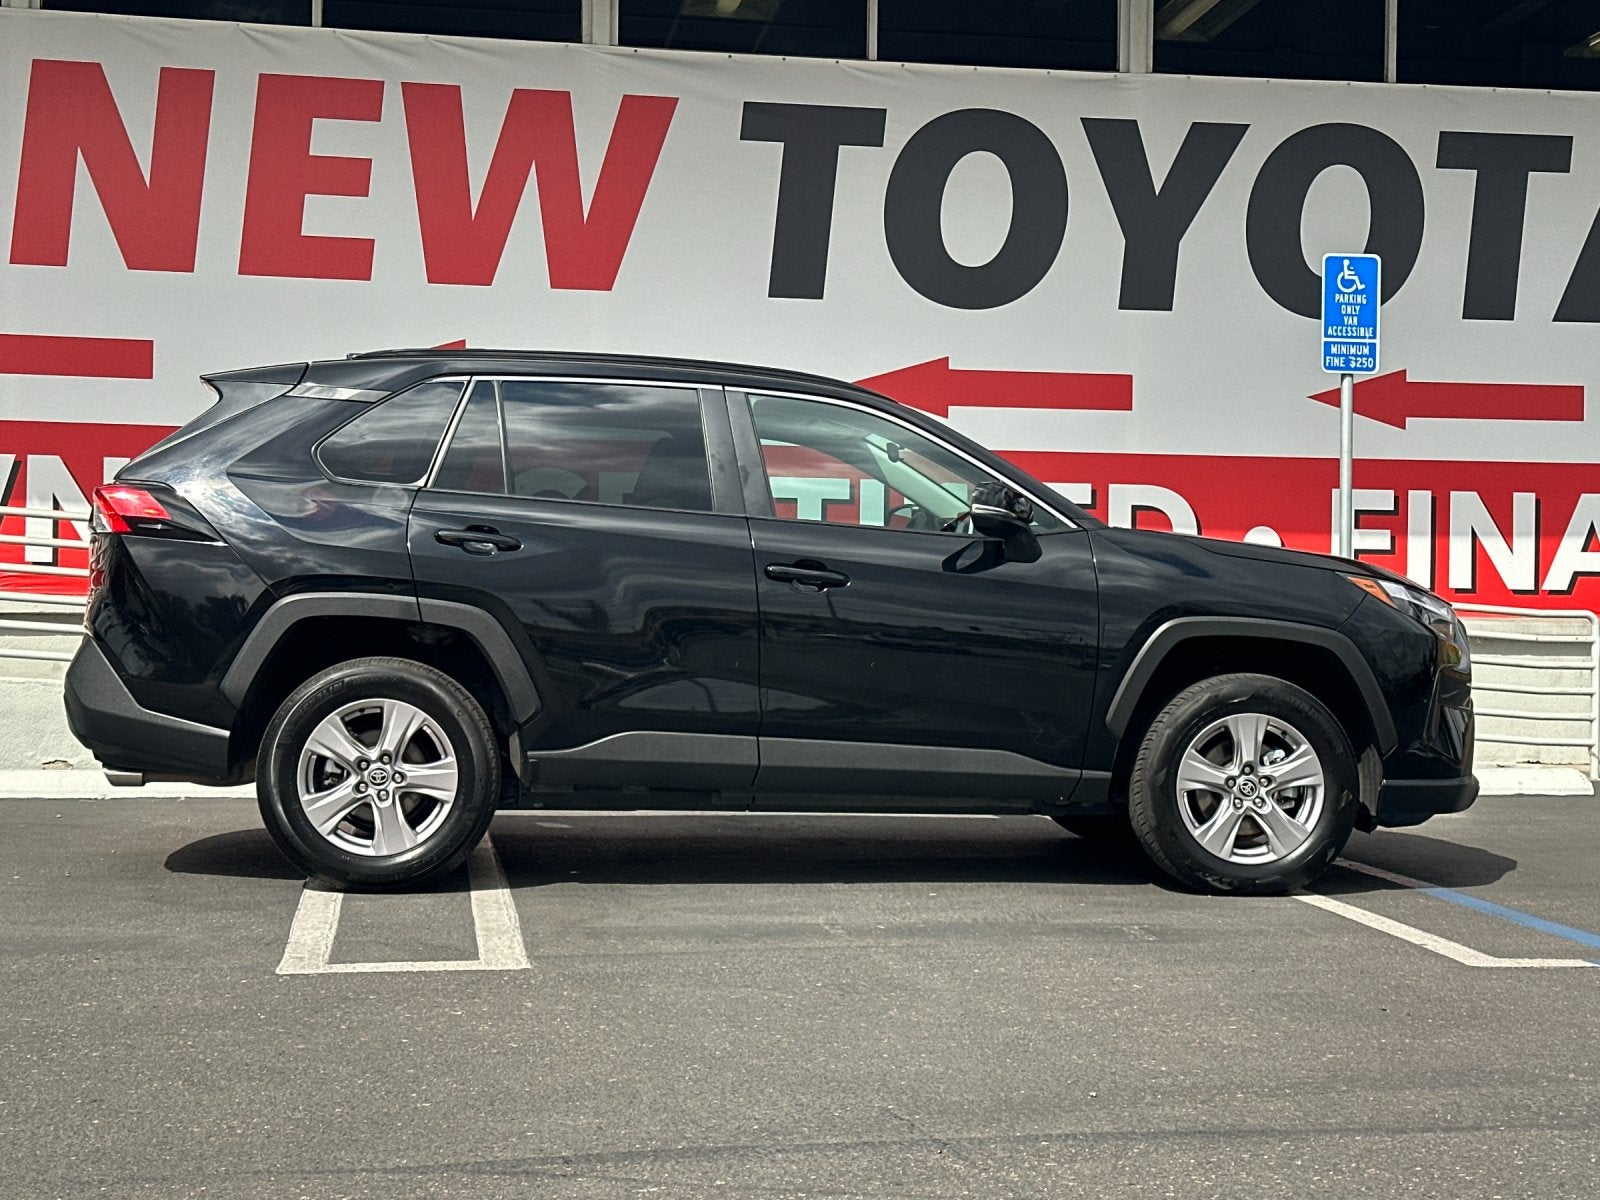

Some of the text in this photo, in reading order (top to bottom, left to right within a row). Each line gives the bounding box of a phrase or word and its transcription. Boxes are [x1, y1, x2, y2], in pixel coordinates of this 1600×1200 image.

[10, 59, 1600, 324] NEW TOYOT
[1335, 293, 1367, 304] PARKING
[1341, 305, 1360, 315] ONLY
[1343, 316, 1358, 326] VAN
[1327, 326, 1373, 337] ACCESSIBLE
[1330, 344, 1369, 355] MINIMUM
[1325, 356, 1374, 368] FINE $250
